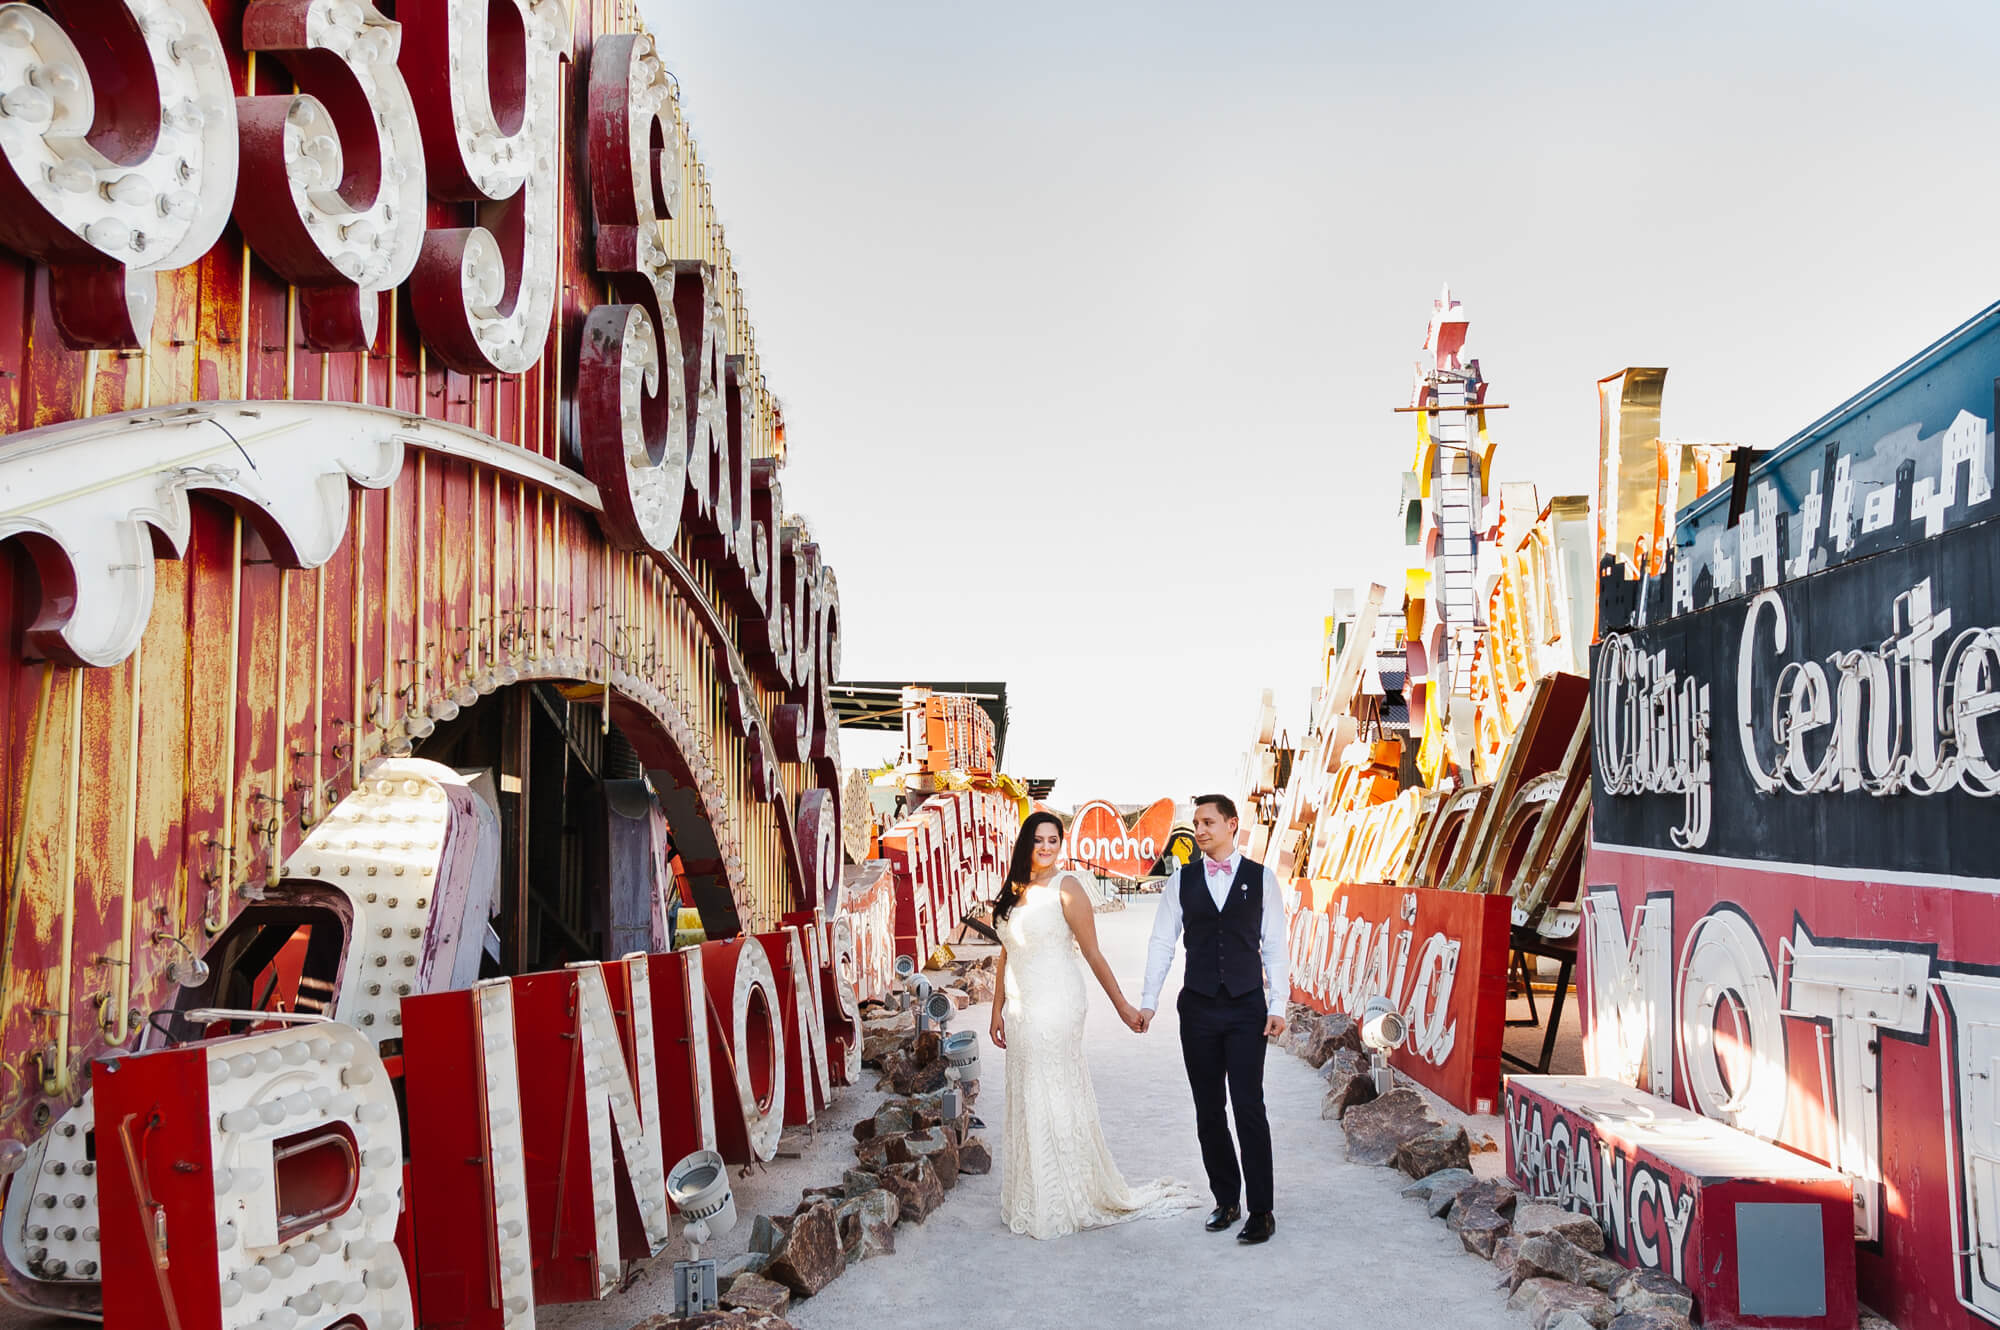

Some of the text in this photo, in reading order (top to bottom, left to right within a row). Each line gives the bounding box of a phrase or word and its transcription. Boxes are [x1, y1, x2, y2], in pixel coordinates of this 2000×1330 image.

[1070, 802, 1156, 871] Concha
[1594, 631, 1712, 850] City
[1505, 1091, 1695, 1284] VACANCY
